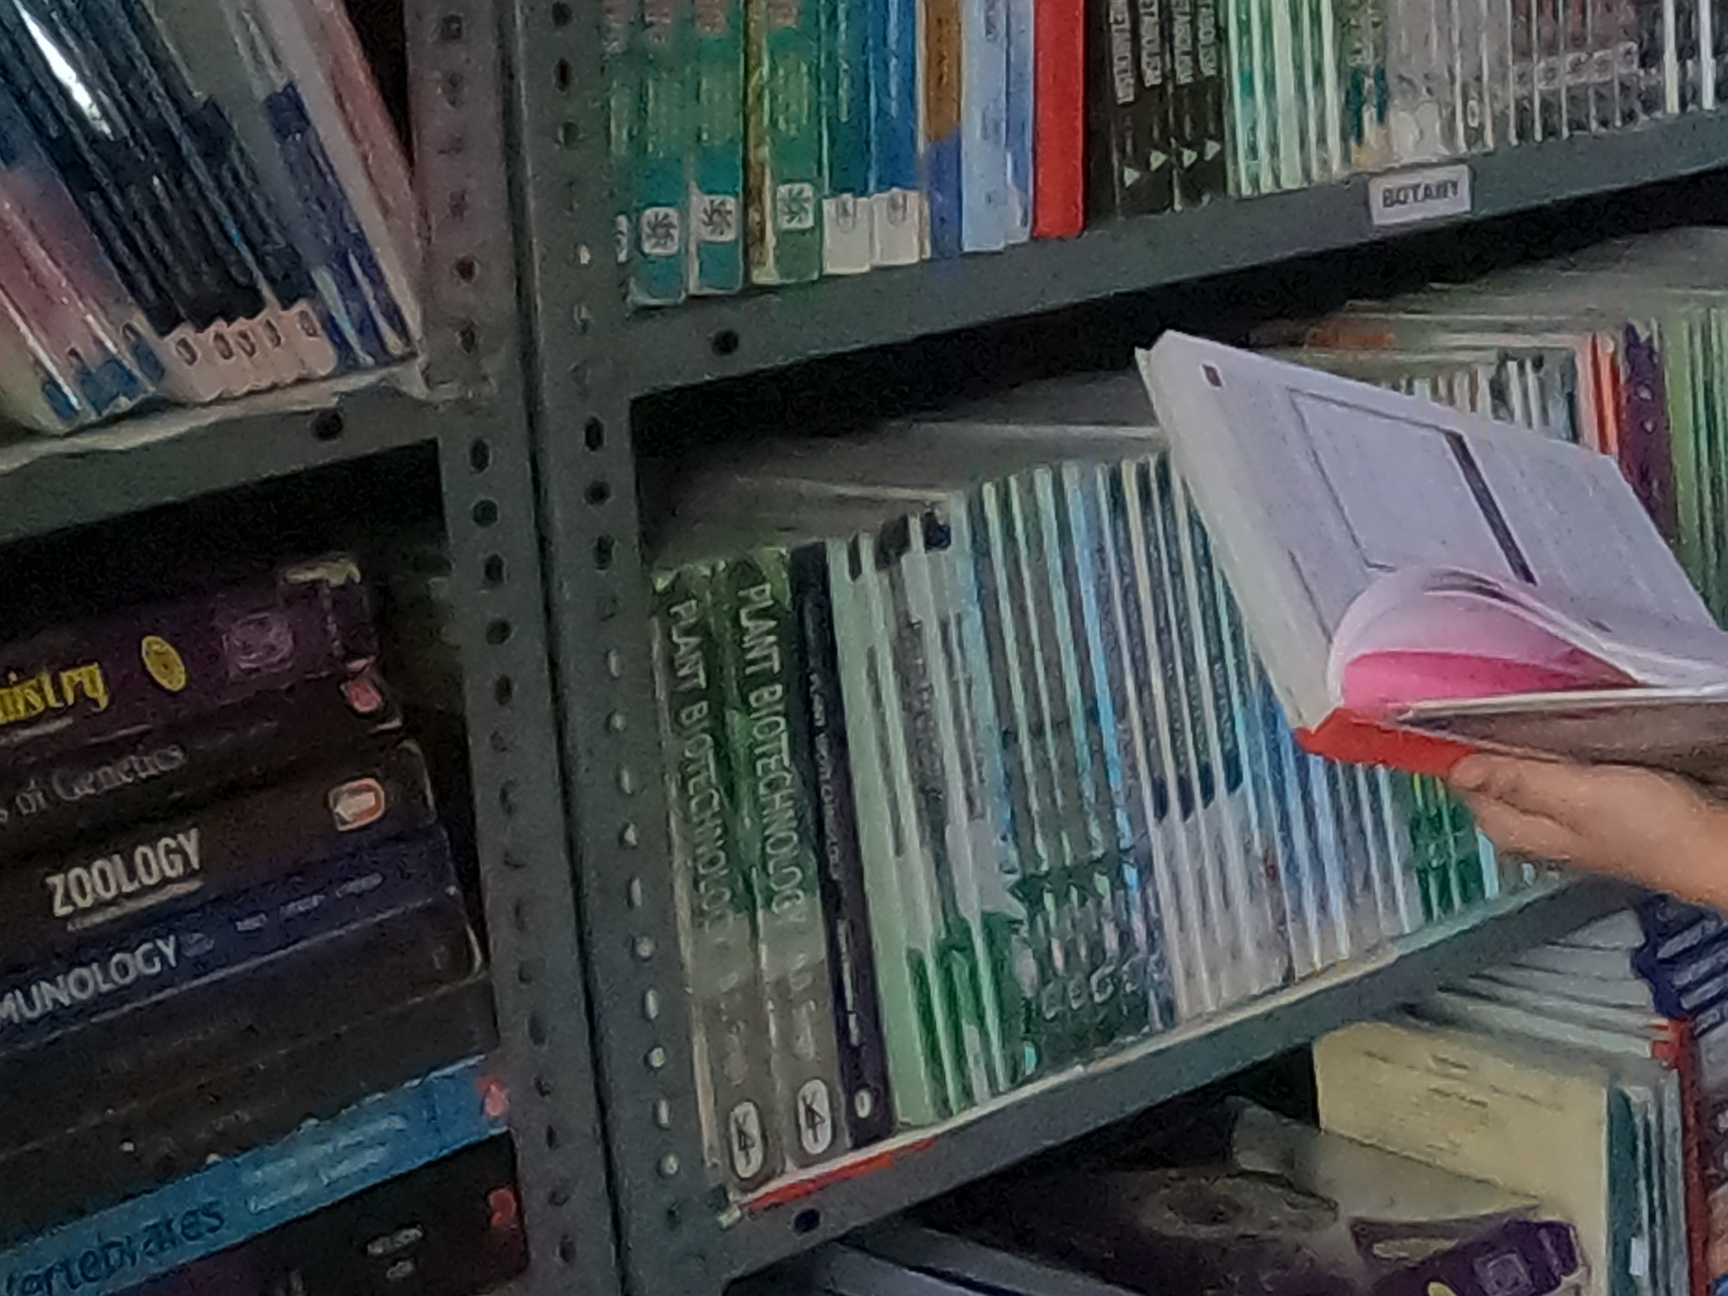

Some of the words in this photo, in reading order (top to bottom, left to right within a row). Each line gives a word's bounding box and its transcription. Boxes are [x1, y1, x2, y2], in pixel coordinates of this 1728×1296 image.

[1381, 178, 1462, 210] BOTANY
[668, 599, 707, 693] PLANT
[736, 581, 782, 677] PLANT
[0, 661, 109, 724] istry
[52, 744, 188, 802] Genetics
[46, 828, 200, 918] ZOOLOGY
